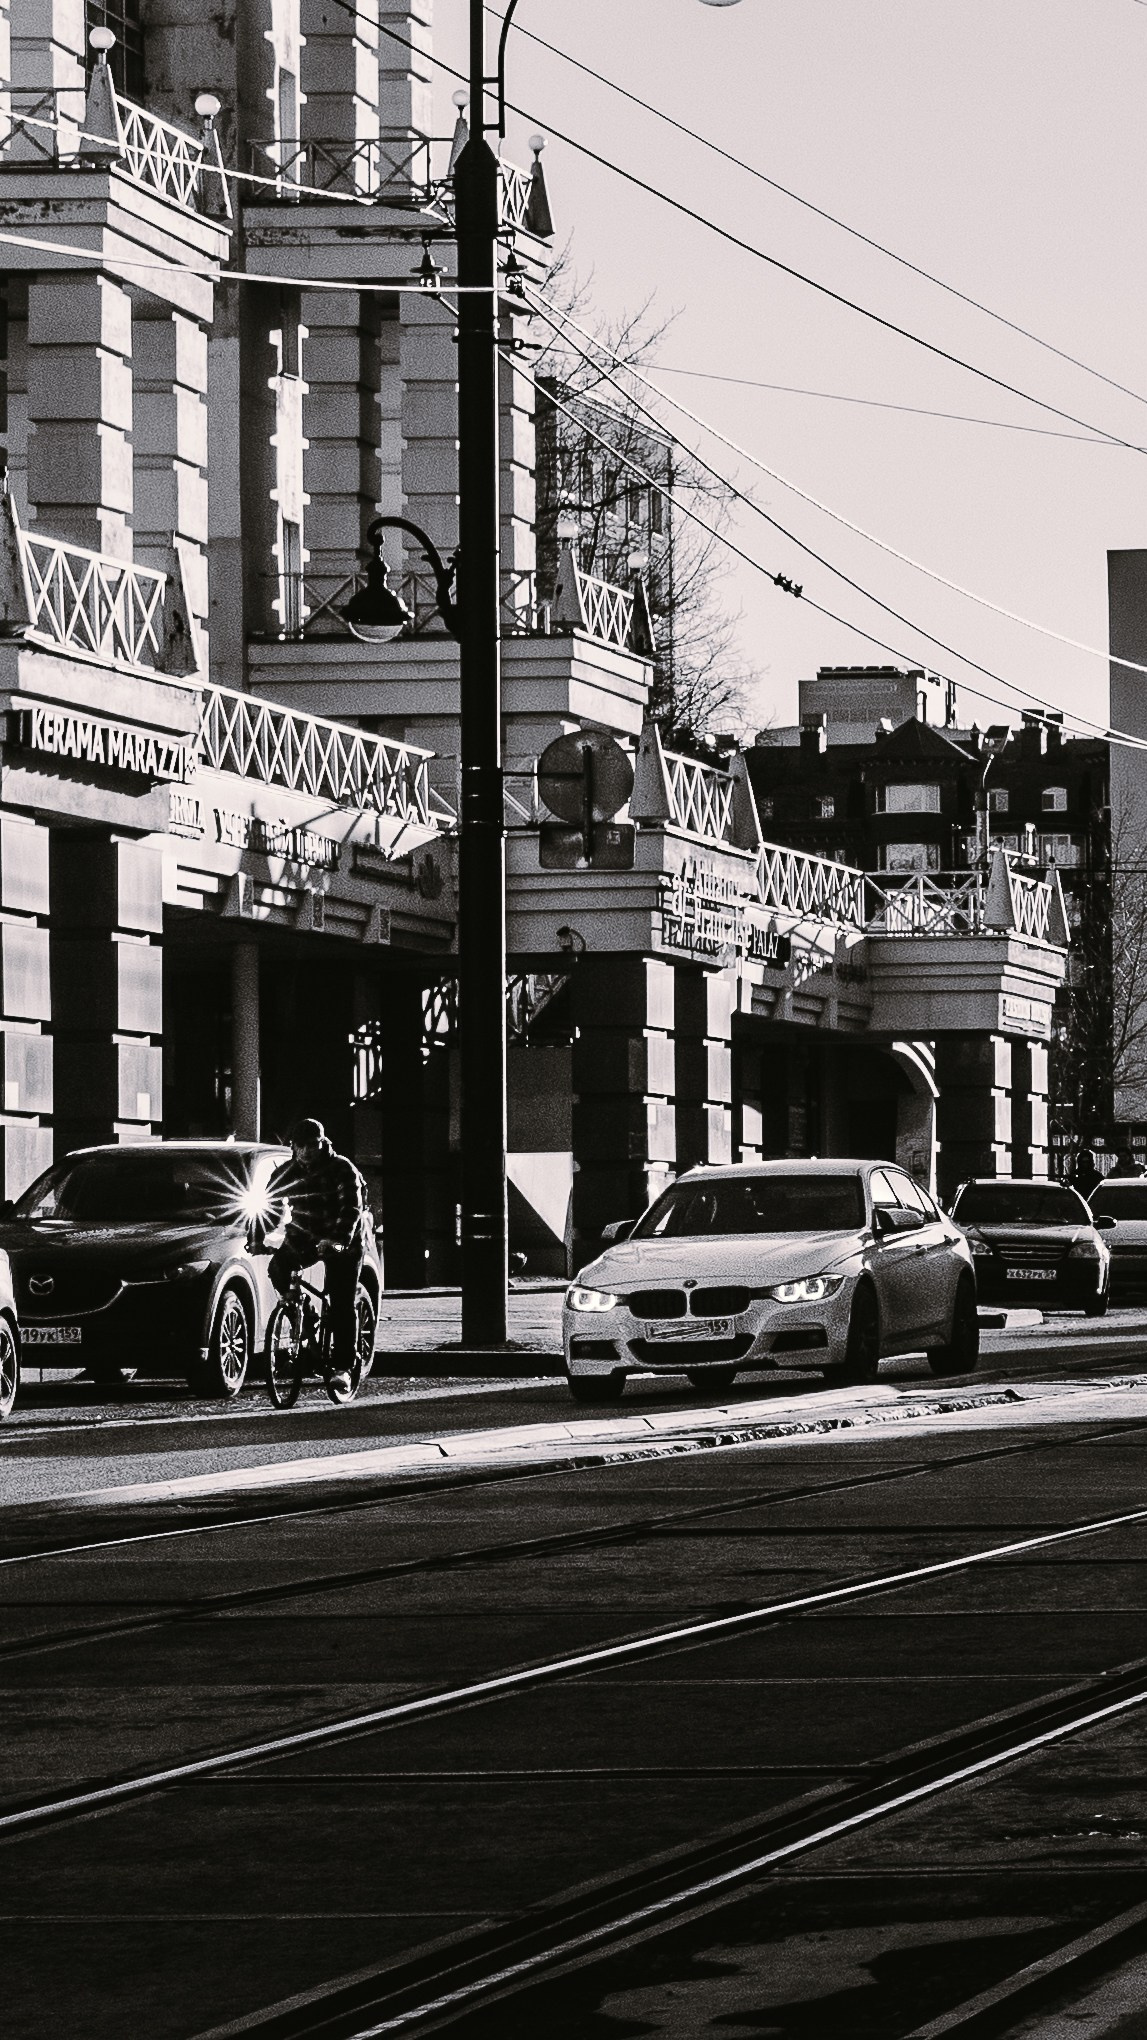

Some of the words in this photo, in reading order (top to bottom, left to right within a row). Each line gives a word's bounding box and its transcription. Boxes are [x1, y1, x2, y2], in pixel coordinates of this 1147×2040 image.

[31, 708, 105, 764] KERAMA
[108, 727, 184, 783] MARAZZI
[216, 808, 293, 856] УЧЕЫЙ
